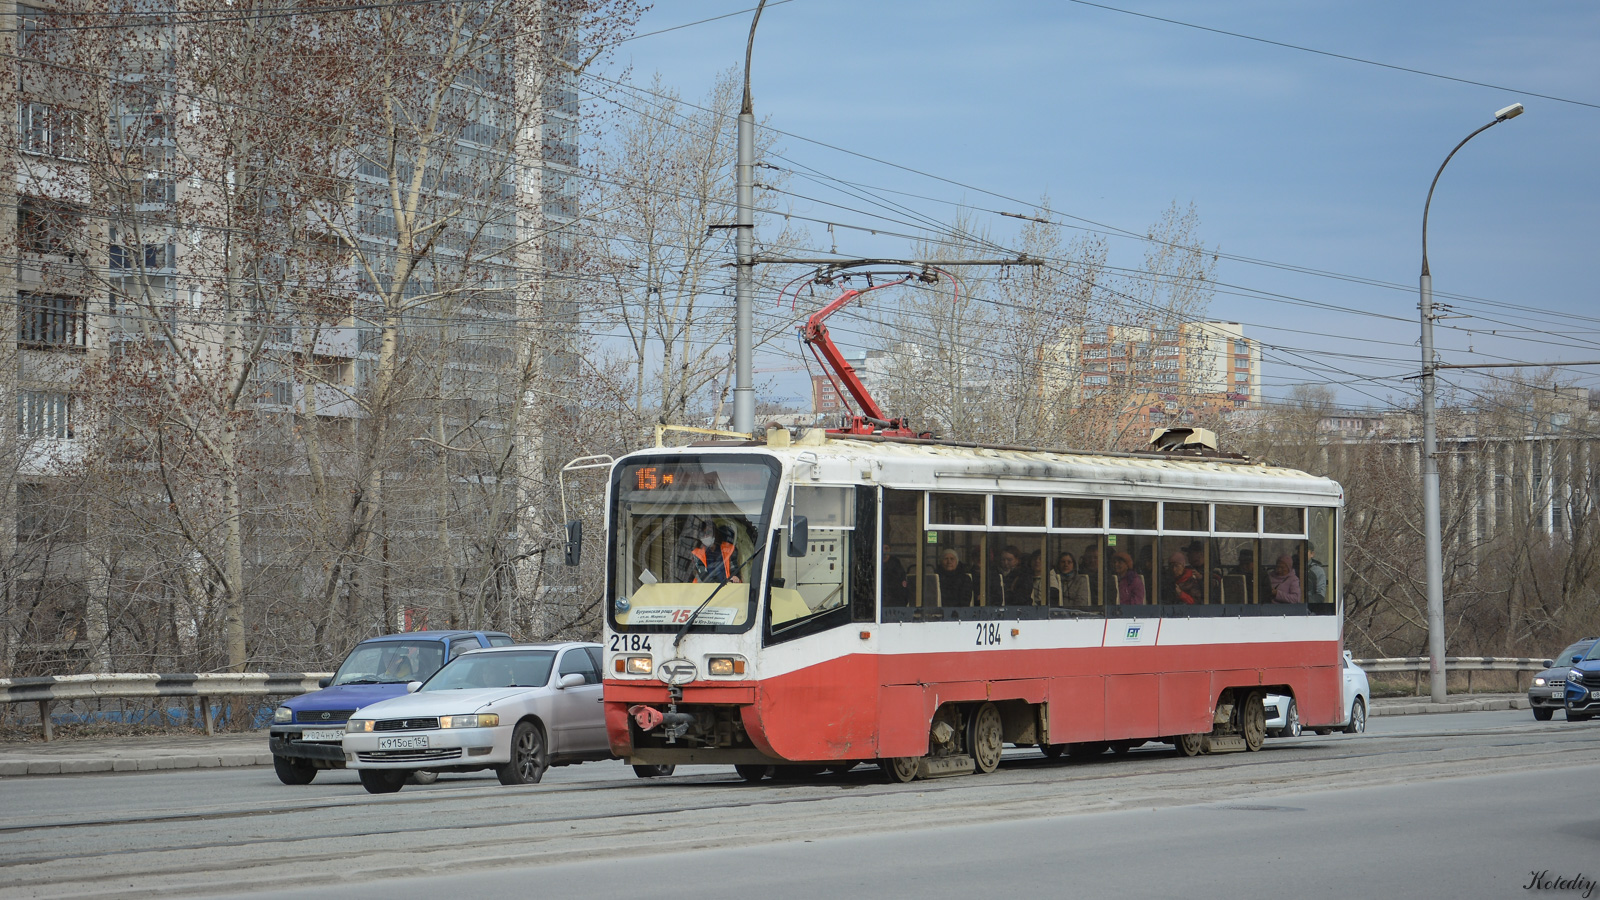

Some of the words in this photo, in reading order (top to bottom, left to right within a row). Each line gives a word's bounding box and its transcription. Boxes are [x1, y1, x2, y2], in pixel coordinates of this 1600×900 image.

[636, 468, 656, 489] 15
[671, 609, 691, 623] 15
[610, 634, 652, 652] 2184
[976, 622, 1001, 646] 2184
[413, 737, 427, 745] 154
